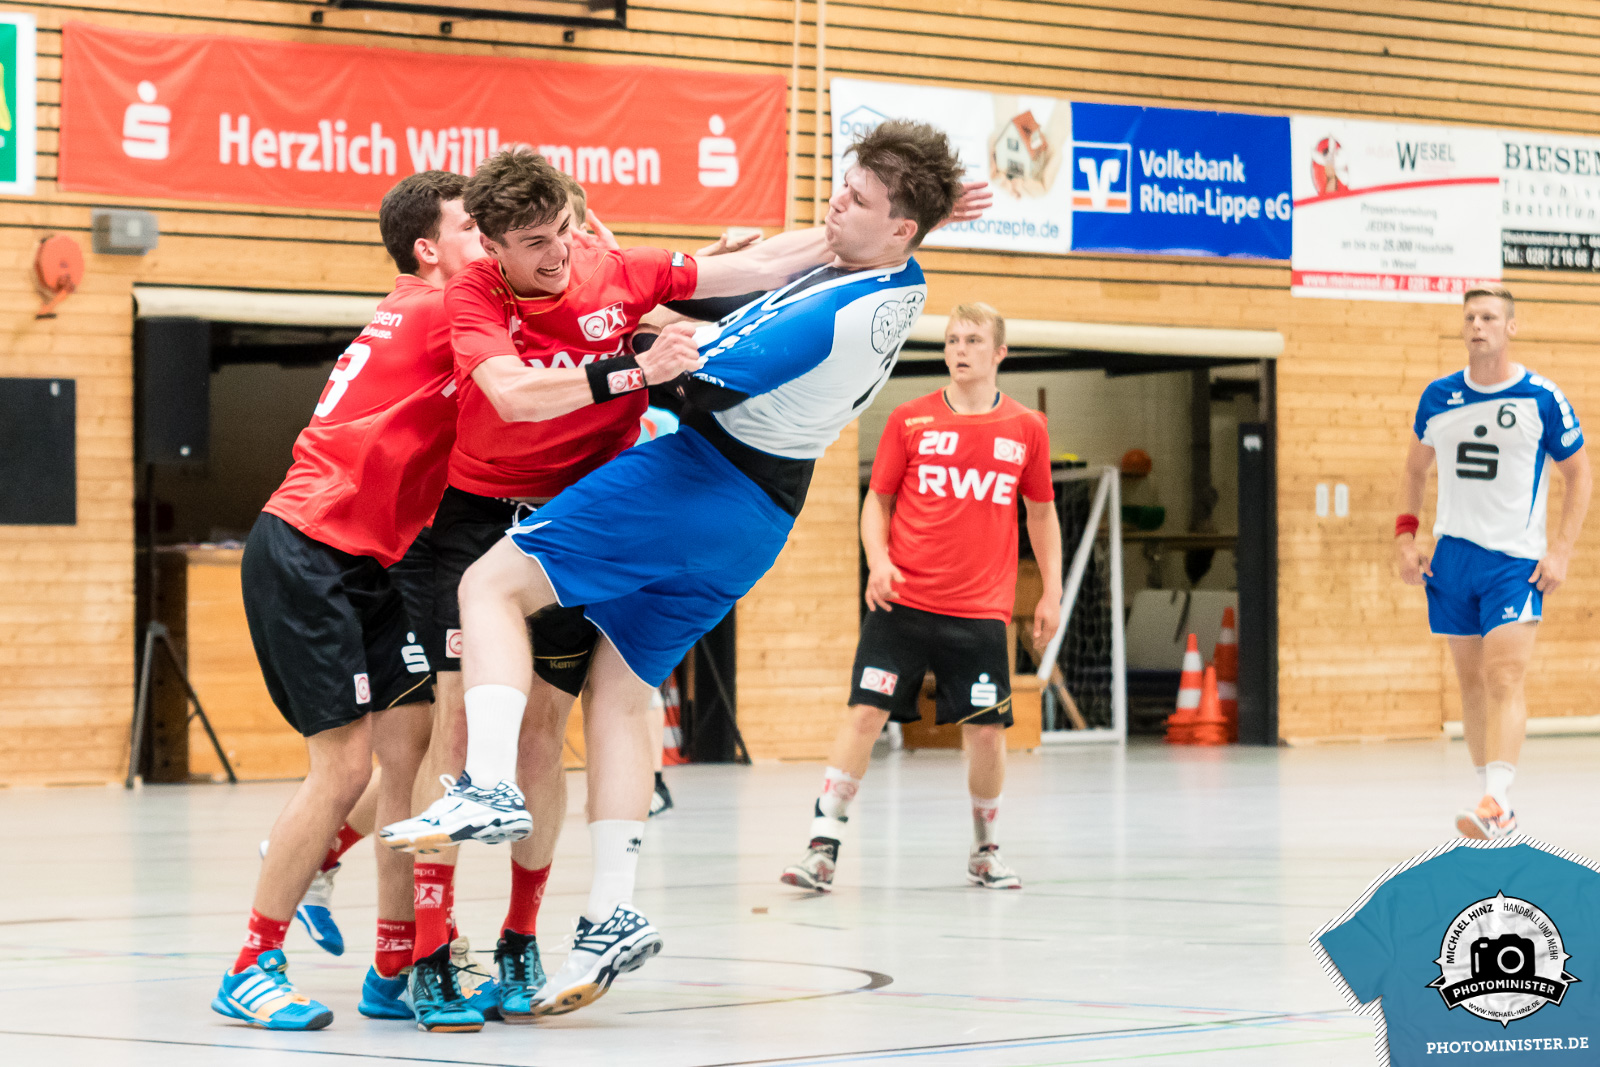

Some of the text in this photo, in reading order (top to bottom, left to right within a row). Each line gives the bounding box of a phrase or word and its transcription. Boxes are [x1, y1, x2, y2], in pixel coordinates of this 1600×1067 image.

[219, 113, 397, 175] Herzlich
[1396, 141, 1456, 171] WESEL
[1139, 149, 1246, 183] Volksbank
[1139, 184, 1291, 224] Rhein-Lippe eG
[1366, 220, 1397, 233] JEDEN
[1496, 402, 1517, 429] 6
[918, 430, 959, 456] 20
[918, 464, 1018, 506] RWE
